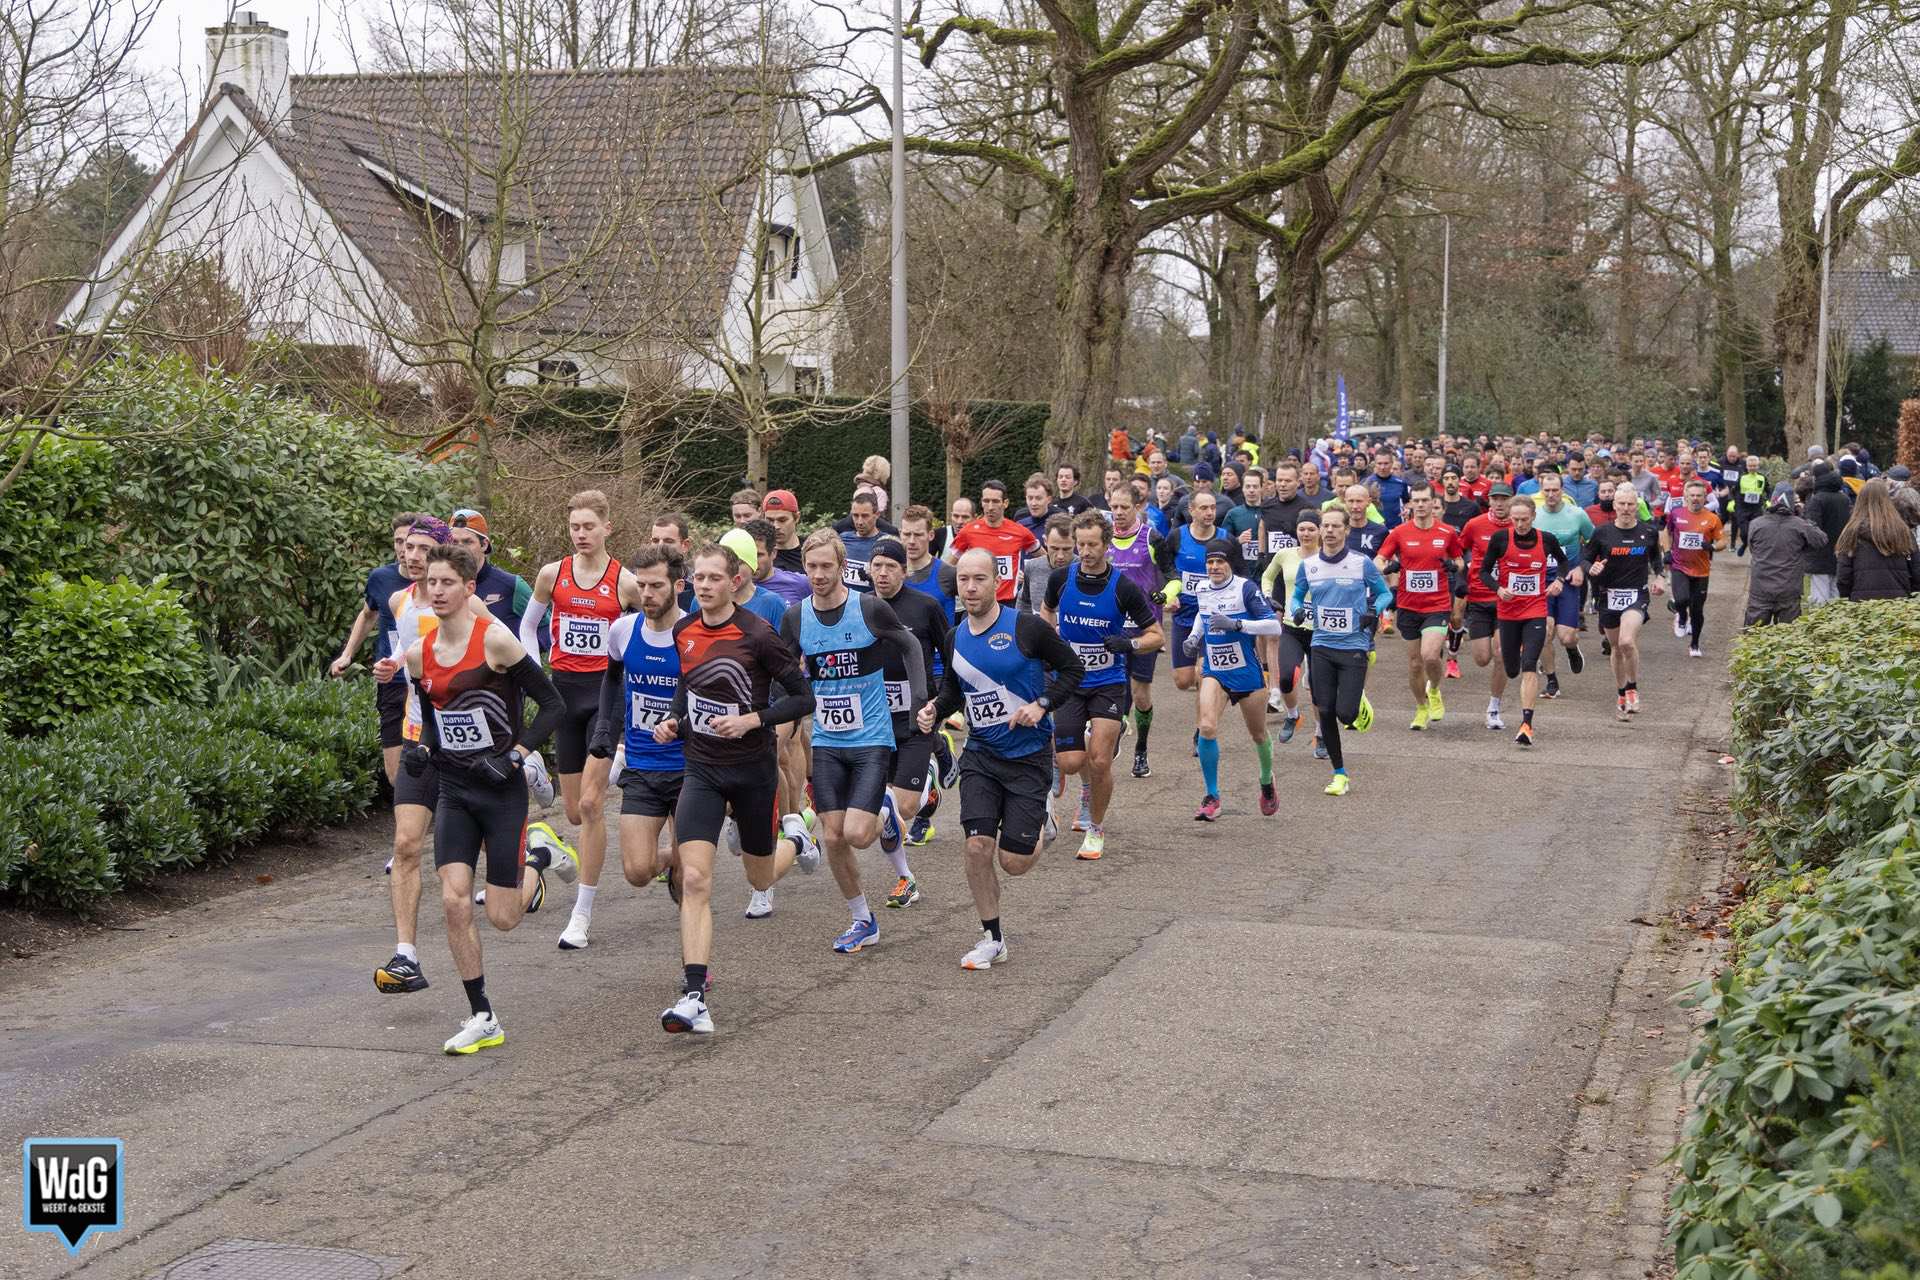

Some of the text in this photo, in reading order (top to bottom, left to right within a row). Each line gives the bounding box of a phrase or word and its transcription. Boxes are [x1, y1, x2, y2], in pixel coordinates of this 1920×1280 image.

[1272, 539, 1294, 549] 756
[1361, 533, 1374, 549] K
[1683, 539, 1700, 547] 725
[1410, 579, 1434, 589] 699
[1079, 616, 1111, 628] WEERT
[1321, 615, 1347, 629] 738
[564, 631, 601, 650] 830
[1211, 652, 1239, 666] 826
[646, 674, 679, 687] WEER
[639, 707, 672, 726] 77
[821, 708, 856, 725] 760
[972, 701, 1008, 722] 842
[443, 725, 483, 744] 693
